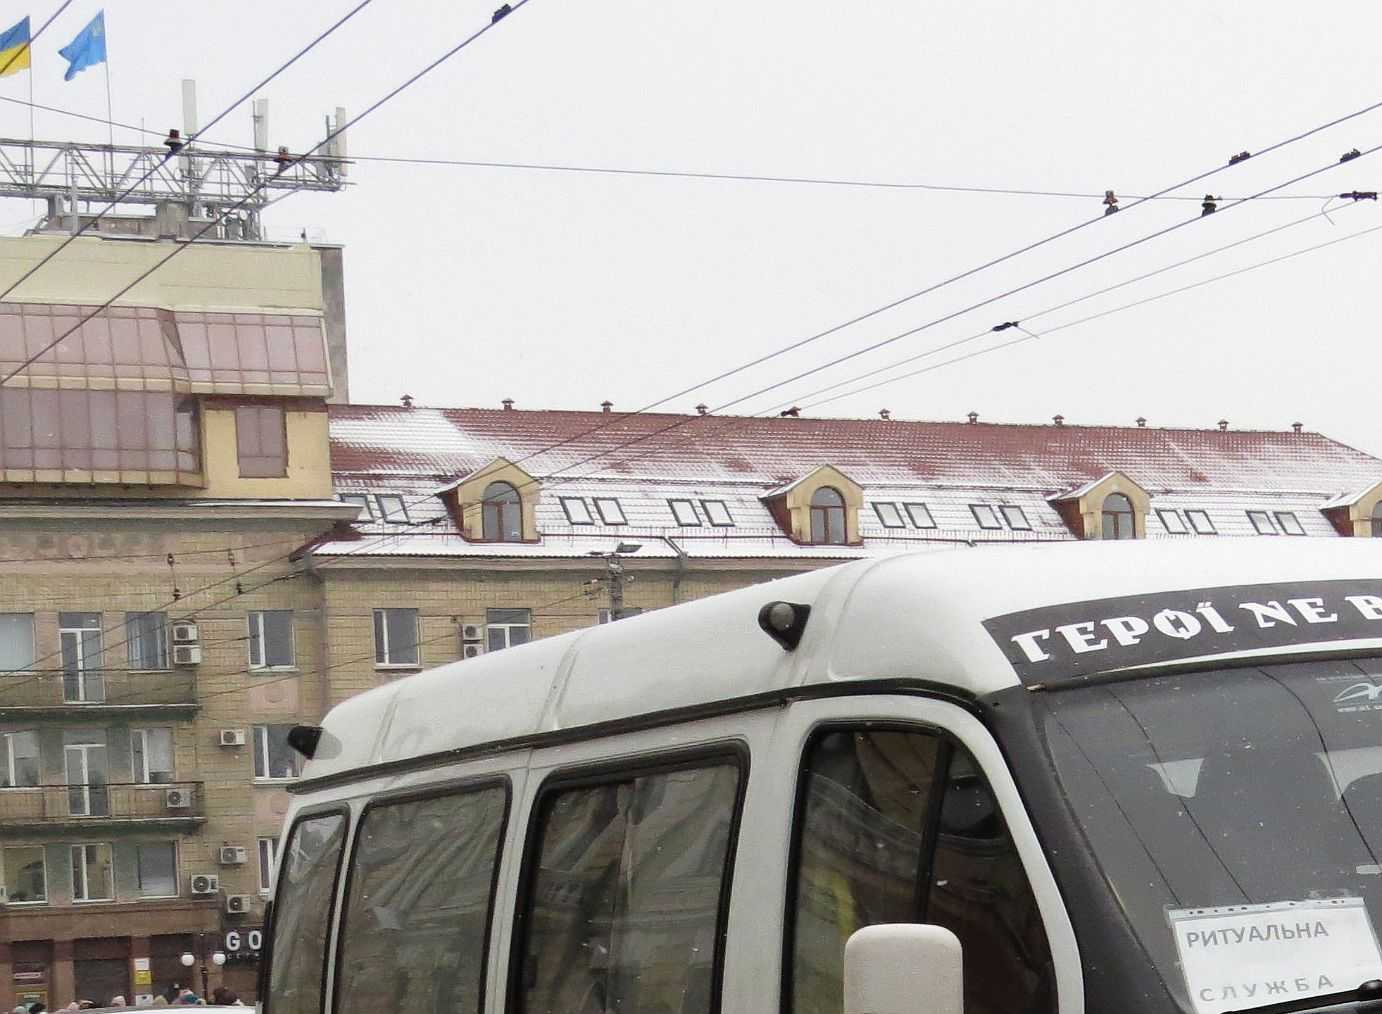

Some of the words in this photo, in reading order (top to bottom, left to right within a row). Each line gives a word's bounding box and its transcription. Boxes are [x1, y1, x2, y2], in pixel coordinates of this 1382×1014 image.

[1010, 601, 1235, 663] ГЕРОЇ
[1186, 920, 1329, 948] РИТУАЛЬНА
[1199, 973, 1334, 1002] СЛУЖБА
